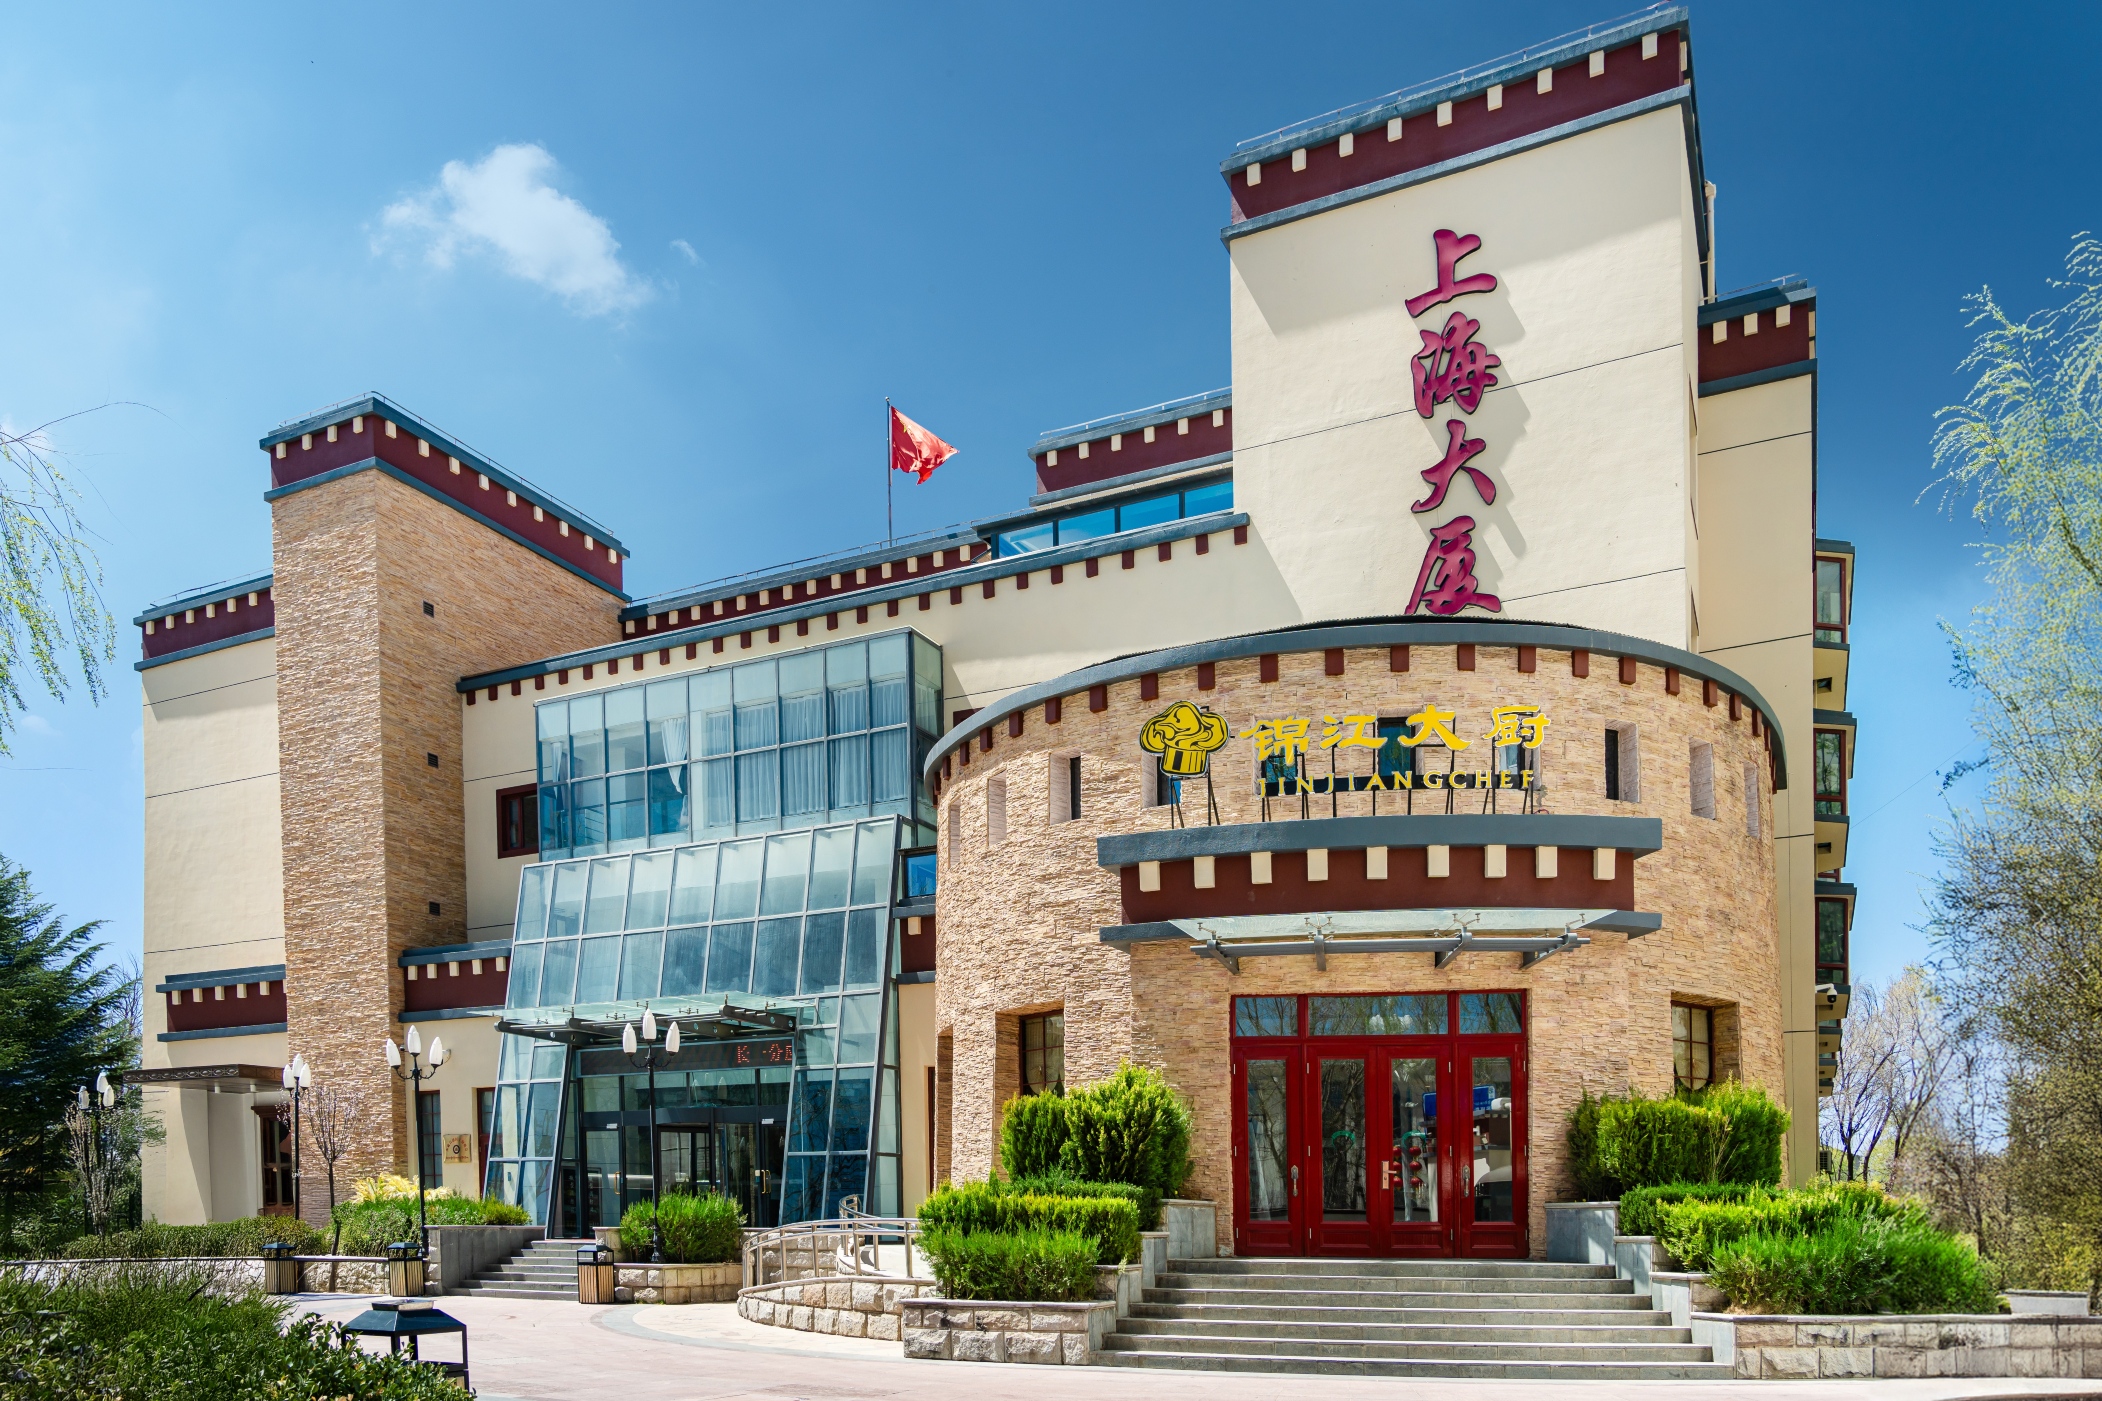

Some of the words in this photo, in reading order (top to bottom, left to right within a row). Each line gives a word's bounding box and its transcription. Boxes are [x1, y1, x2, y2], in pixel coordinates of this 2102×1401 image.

[1404, 228, 1501, 616] 上海大厦
[1239, 704, 1552, 766] 锦江大厨
